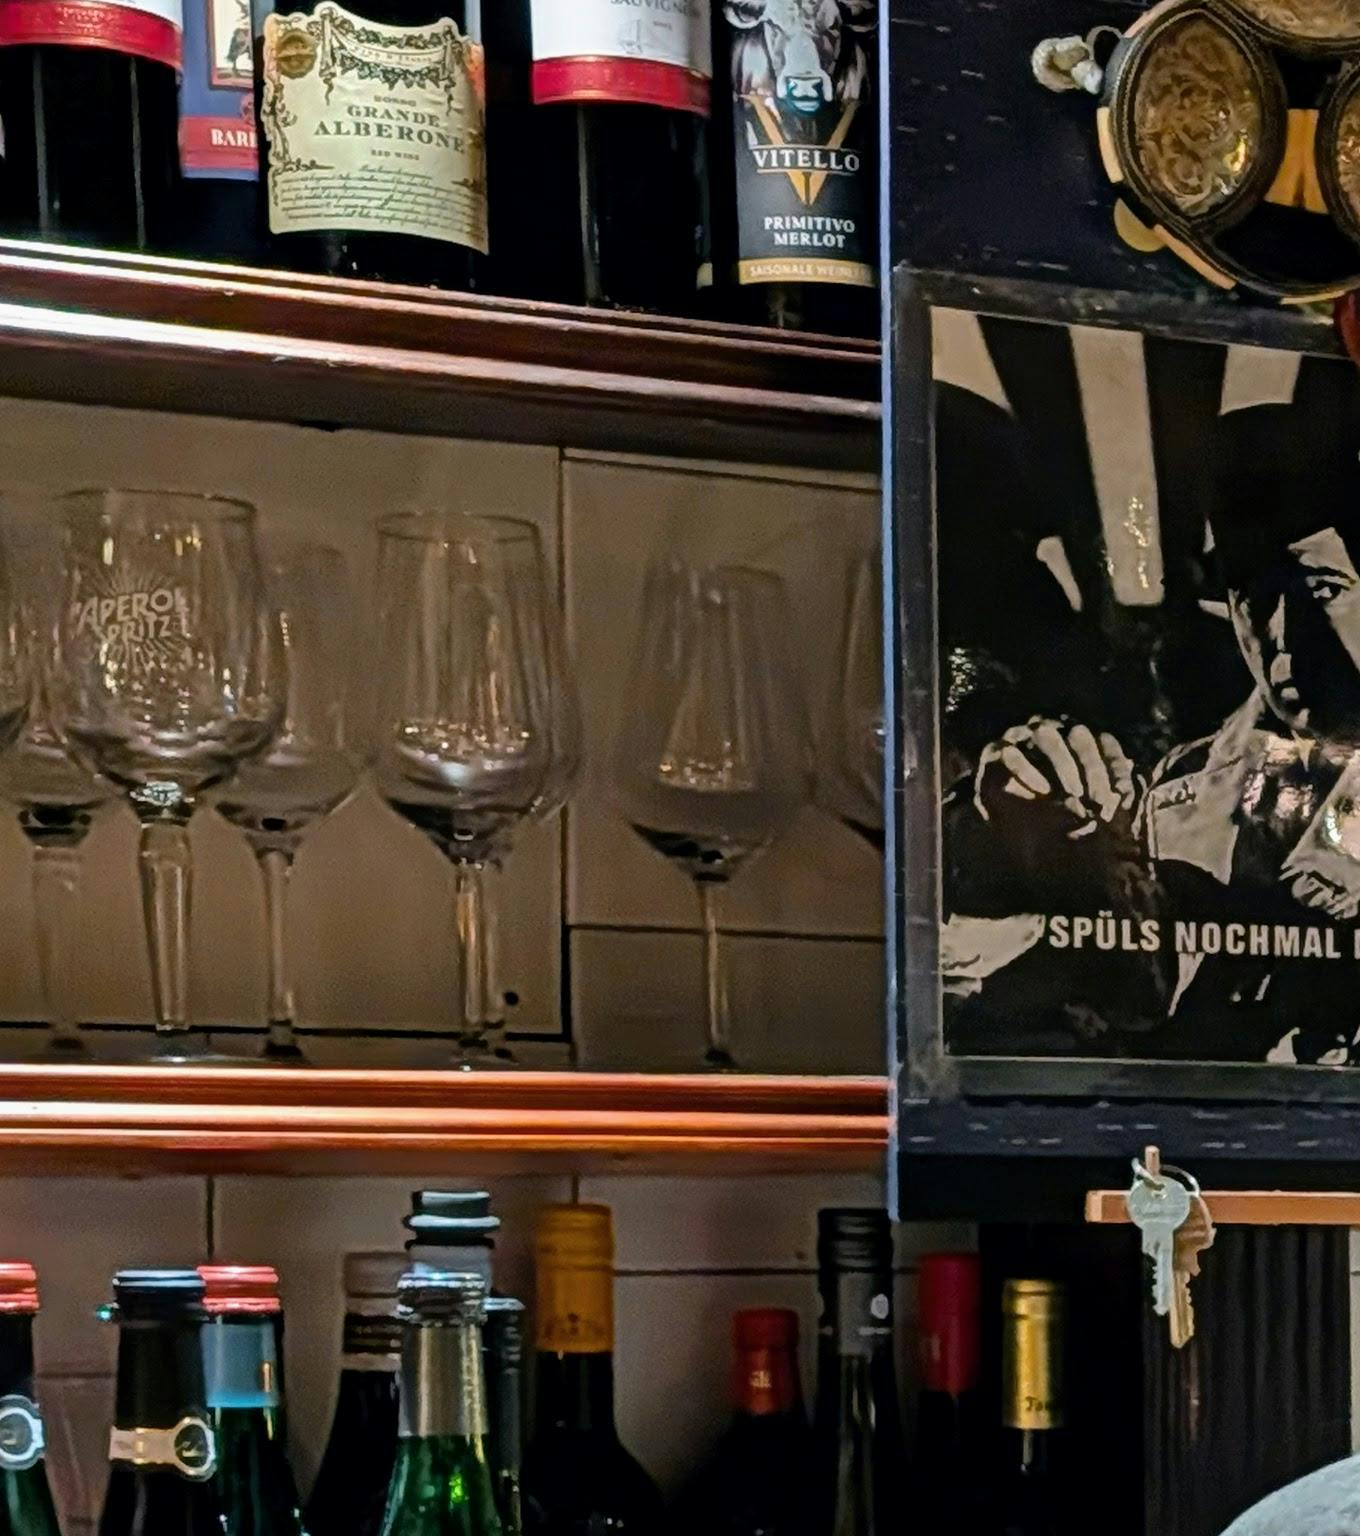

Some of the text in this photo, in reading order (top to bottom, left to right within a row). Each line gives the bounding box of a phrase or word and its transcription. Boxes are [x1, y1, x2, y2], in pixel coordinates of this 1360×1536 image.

[346, 104, 441, 127] GRANDE
[313, 121, 466, 154] ALBERONE
[752, 149, 860, 171] VITELLO
[763, 216, 856, 233] PRIMITIVO
[773, 232, 846, 248] MERLOT
[1049, 910, 1160, 952] SPÜLS
[1175, 920, 1342, 959] NOCHMAL
